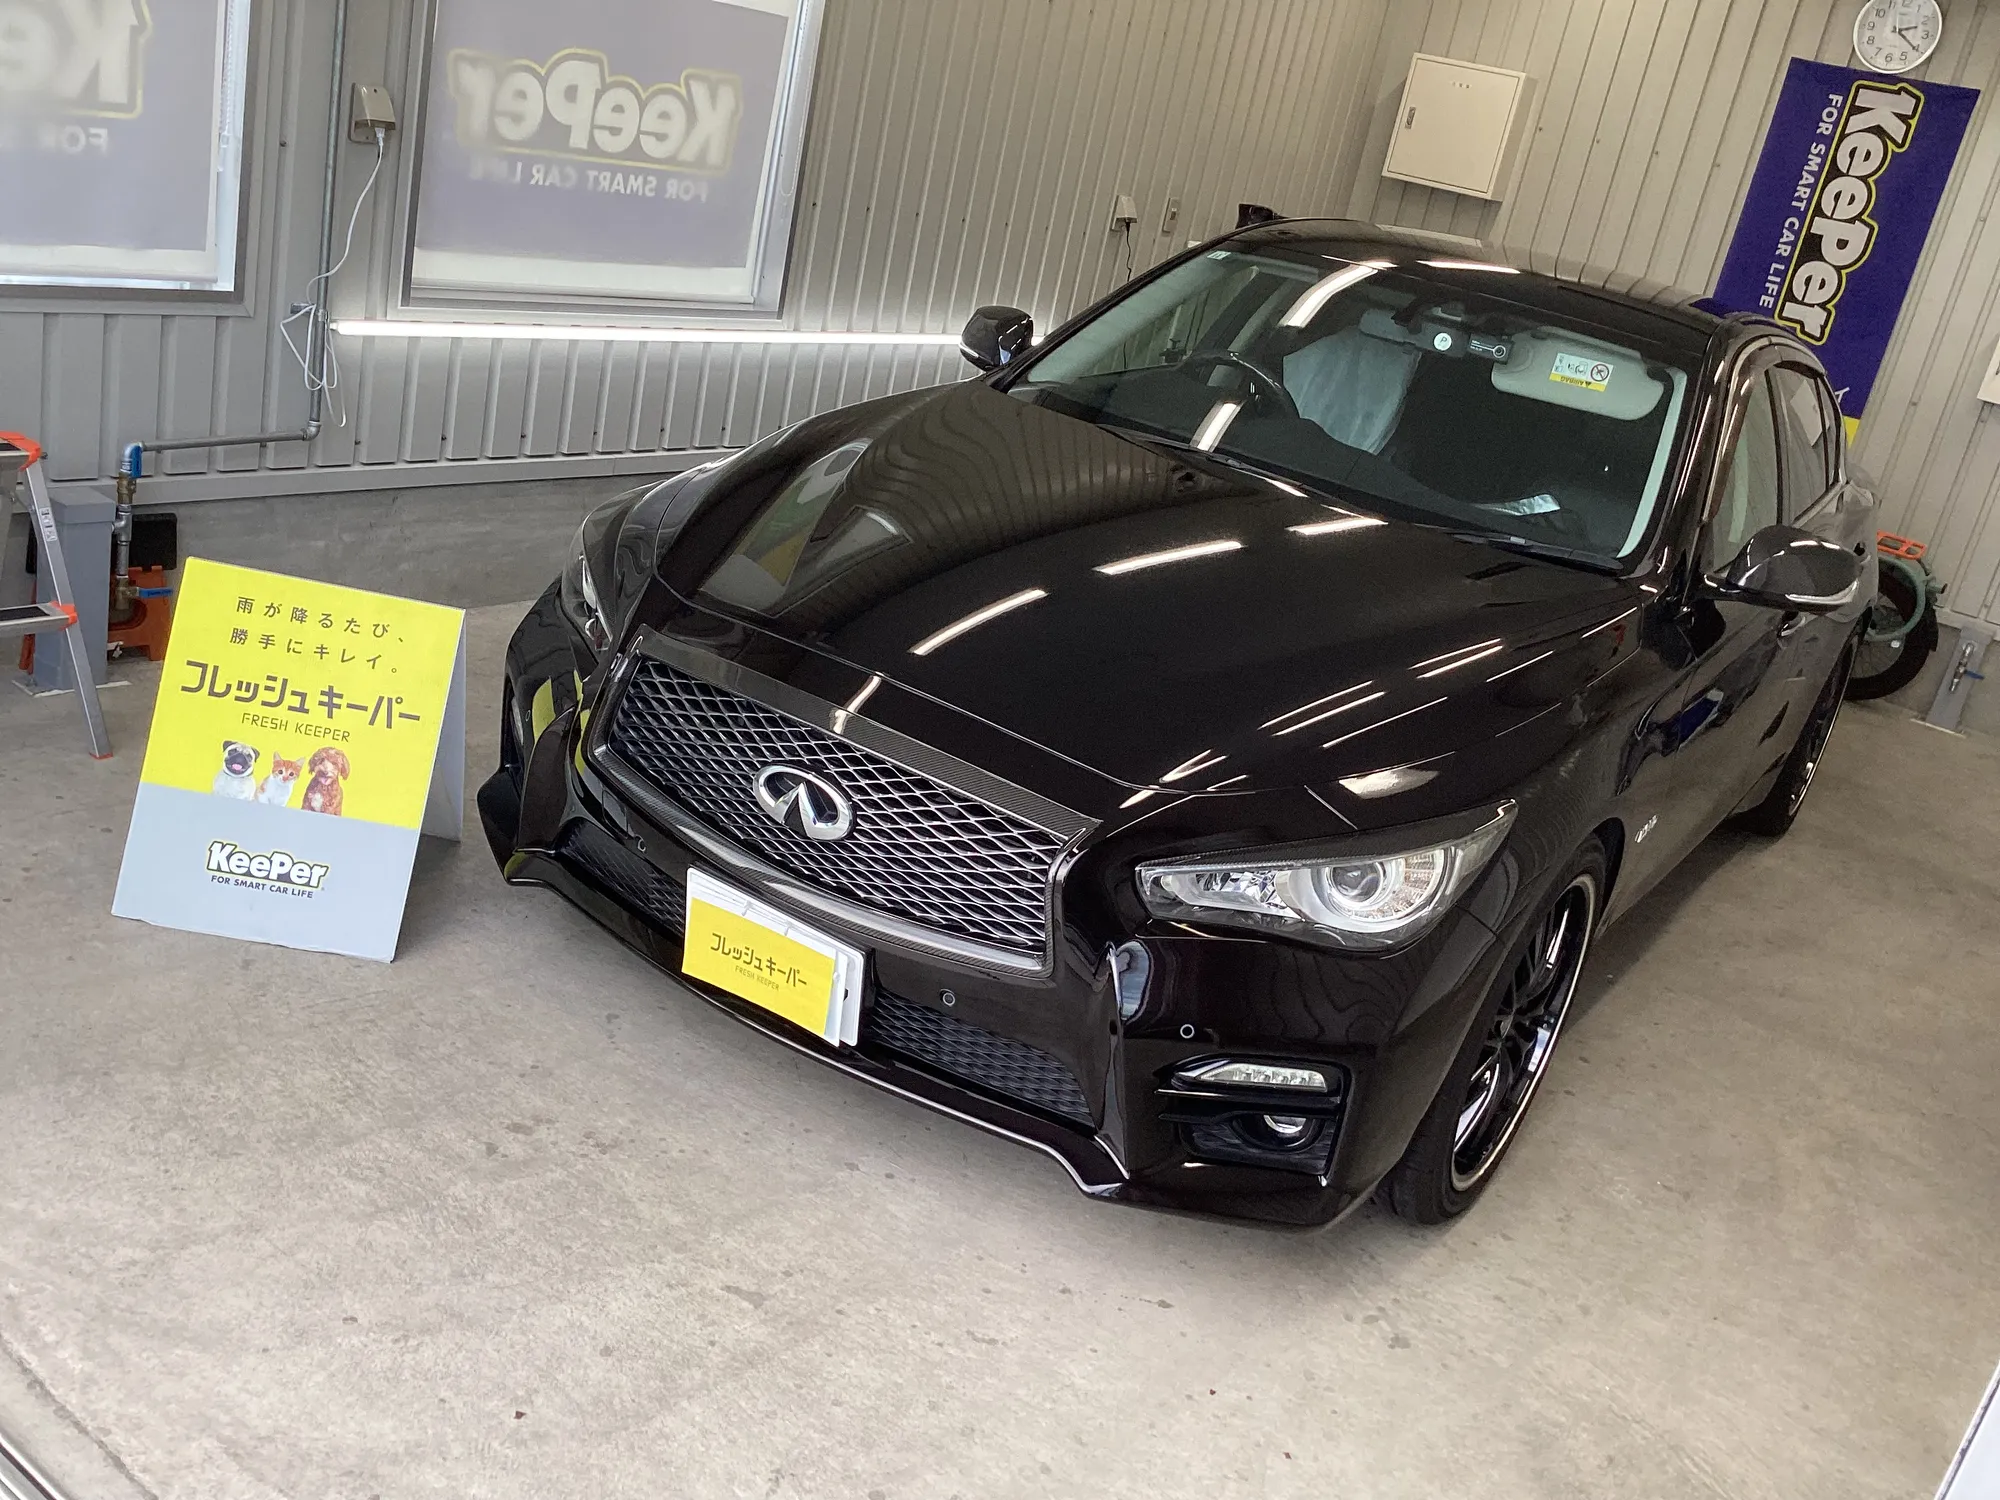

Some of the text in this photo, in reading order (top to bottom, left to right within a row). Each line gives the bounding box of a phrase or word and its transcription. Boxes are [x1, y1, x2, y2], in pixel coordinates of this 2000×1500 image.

[1867, 21, 1875, 30] 9
[1875, 8, 1886, 18] 10
[1866, 36, 1875, 45] 8
[1921, 30, 1929, 39] 3
[1874, 47, 1882, 56] 7
[1885, 53, 1893, 62] 6
[1900, 51, 1908, 61] 5
[1759, 93, 1844, 309] FOR SMART CAR LIFE
[1780, 86, 1919, 340] KeePer
[236, 596, 404, 643] 雨が降るたび、
[229, 627, 398, 674] 勝手にキレイ。
[180, 659, 421, 730] フレッシュキーパー
[241, 712, 351, 743] FRESH KEEPER
[207, 840, 329, 888] KeePer
[210, 874, 314, 899] FOR SMART CAR LIFE
[710, 932, 807, 987] フレッシュキーパー
[735, 965, 780, 991] FRESH KEEPER
